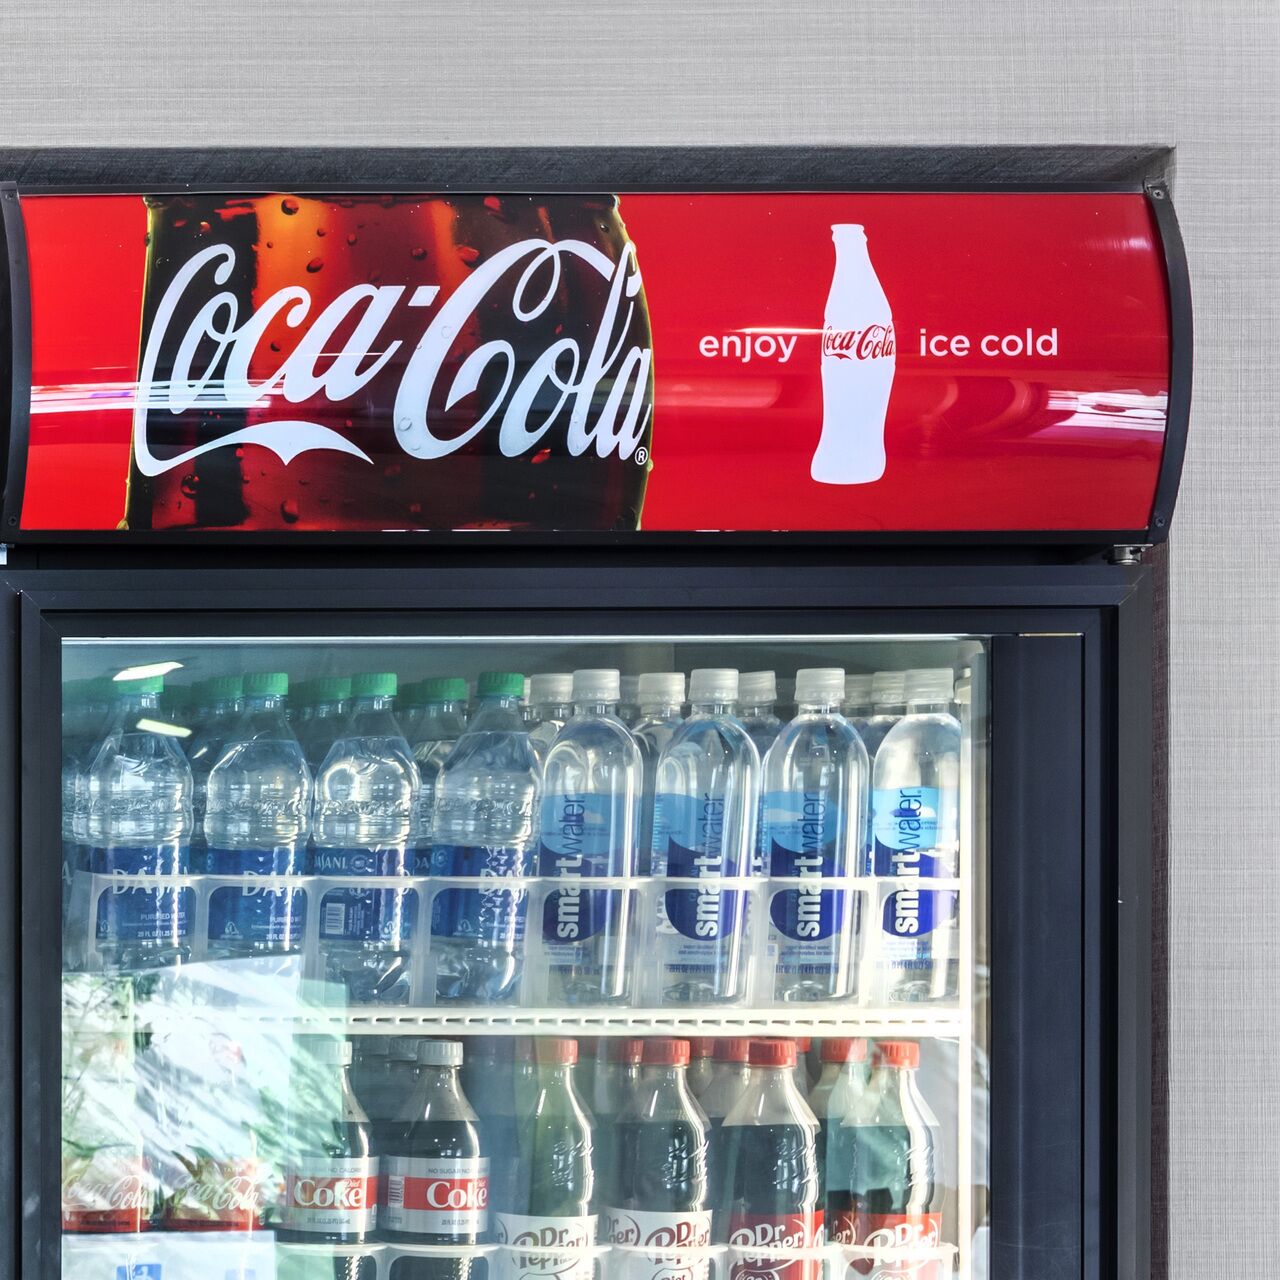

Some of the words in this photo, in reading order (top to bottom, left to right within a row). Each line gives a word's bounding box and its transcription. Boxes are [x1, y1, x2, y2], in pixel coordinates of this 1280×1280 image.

[699, 328, 797, 363] enjoy
[920, 328, 970, 357] ice
[981, 328, 1058, 357] cold
[134, 238, 653, 477] Coca-Cola
[294, 1179, 363, 1207] Coke
[426, 1181, 487, 1209] Coke
[539, 1227, 569, 1243] Dr
[755, 1223, 786, 1244] Dr
[894, 1223, 923, 1245] Dr
